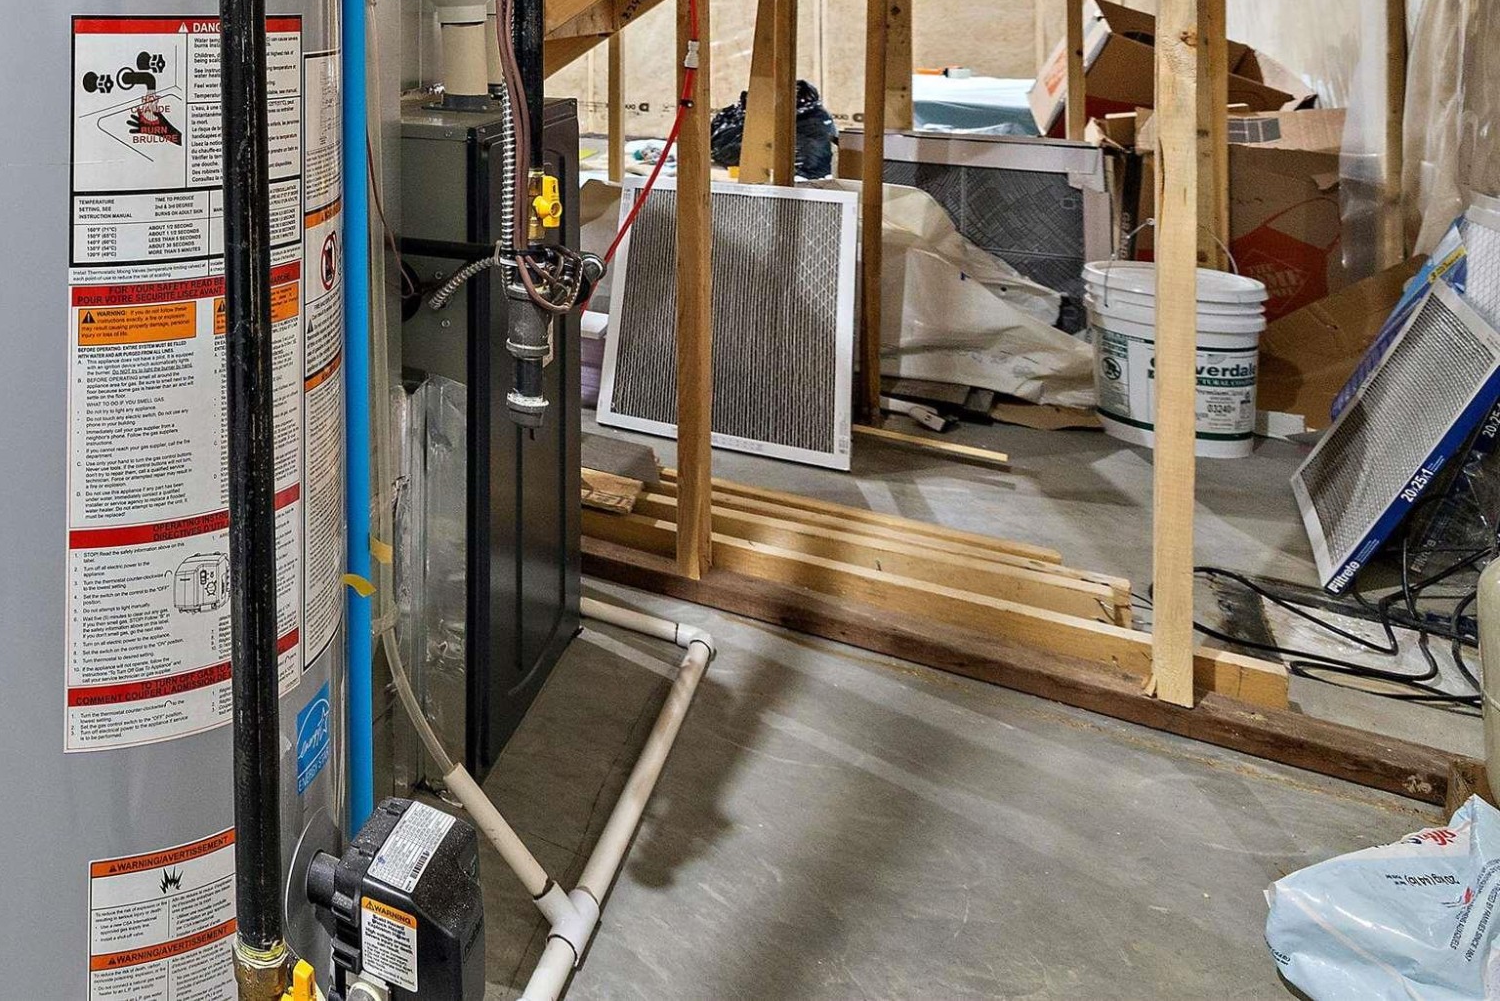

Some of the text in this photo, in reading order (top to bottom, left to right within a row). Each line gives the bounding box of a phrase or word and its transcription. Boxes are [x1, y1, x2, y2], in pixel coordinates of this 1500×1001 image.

[78, 286, 222, 304] POUR VOTRE SECURITE LISEZ AVANT
[109, 279, 212, 294] FOR YOUR SAFETY READ
[1401, 468, 1434, 502] 20x25x1
[153, 519, 196, 533] OPERATING
[154, 526, 200, 541] DIRECTIVES
[1327, 561, 1360, 593] Filtrete
[154, 679, 177, 688] TURN
[180, 675, 196, 683] OFF
[198, 670, 213, 679] GAS
[76, 672, 228, 706] COMMENT COUPER L'ADMISSION DE
[117, 837, 228, 871] WARNING/AVERTISSEMENT
[374, 905, 411, 924] WARNING
[117, 926, 227, 963] WARNING/AVERTISSEMENT
